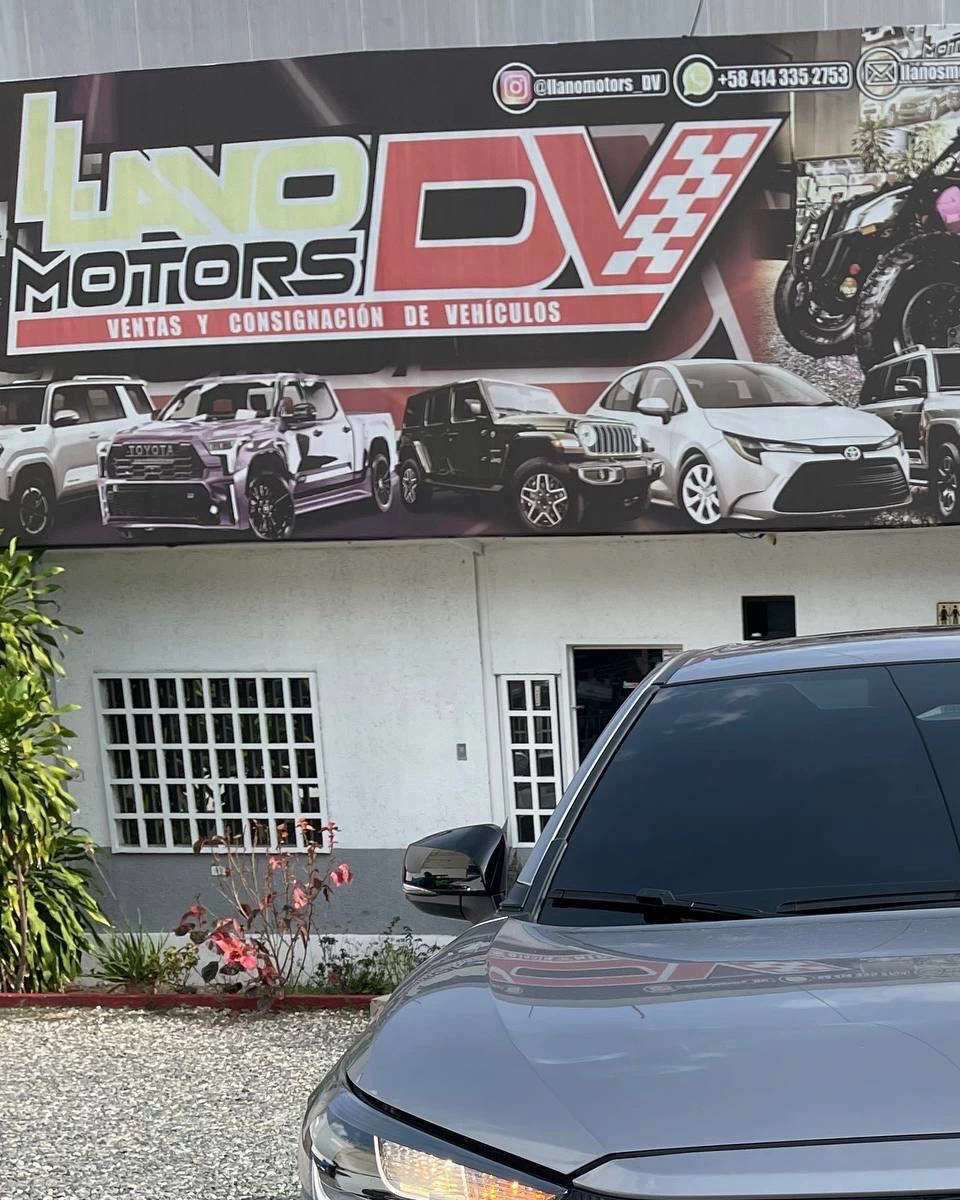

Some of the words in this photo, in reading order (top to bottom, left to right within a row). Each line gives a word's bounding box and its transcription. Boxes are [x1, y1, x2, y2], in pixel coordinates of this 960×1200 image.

[534, 74, 661, 95] @llanomotors_DV
[717, 69, 748, 88] +58
[750, 67, 776, 86] 414
[778, 66, 809, 86] 335
[811, 65, 848, 85] 2753
[370, 118, 783, 291] DV
[14, 236, 361, 313] MOTORS
[107, 315, 182, 338] VENTAS
[197, 314, 208, 335] Y
[228, 303, 384, 334] CONSIGNACIÓN
[404, 305, 430, 326] DE
[445, 300, 561, 326] VEHÍCULOS
[128, 444, 174, 457] TOYOTA
